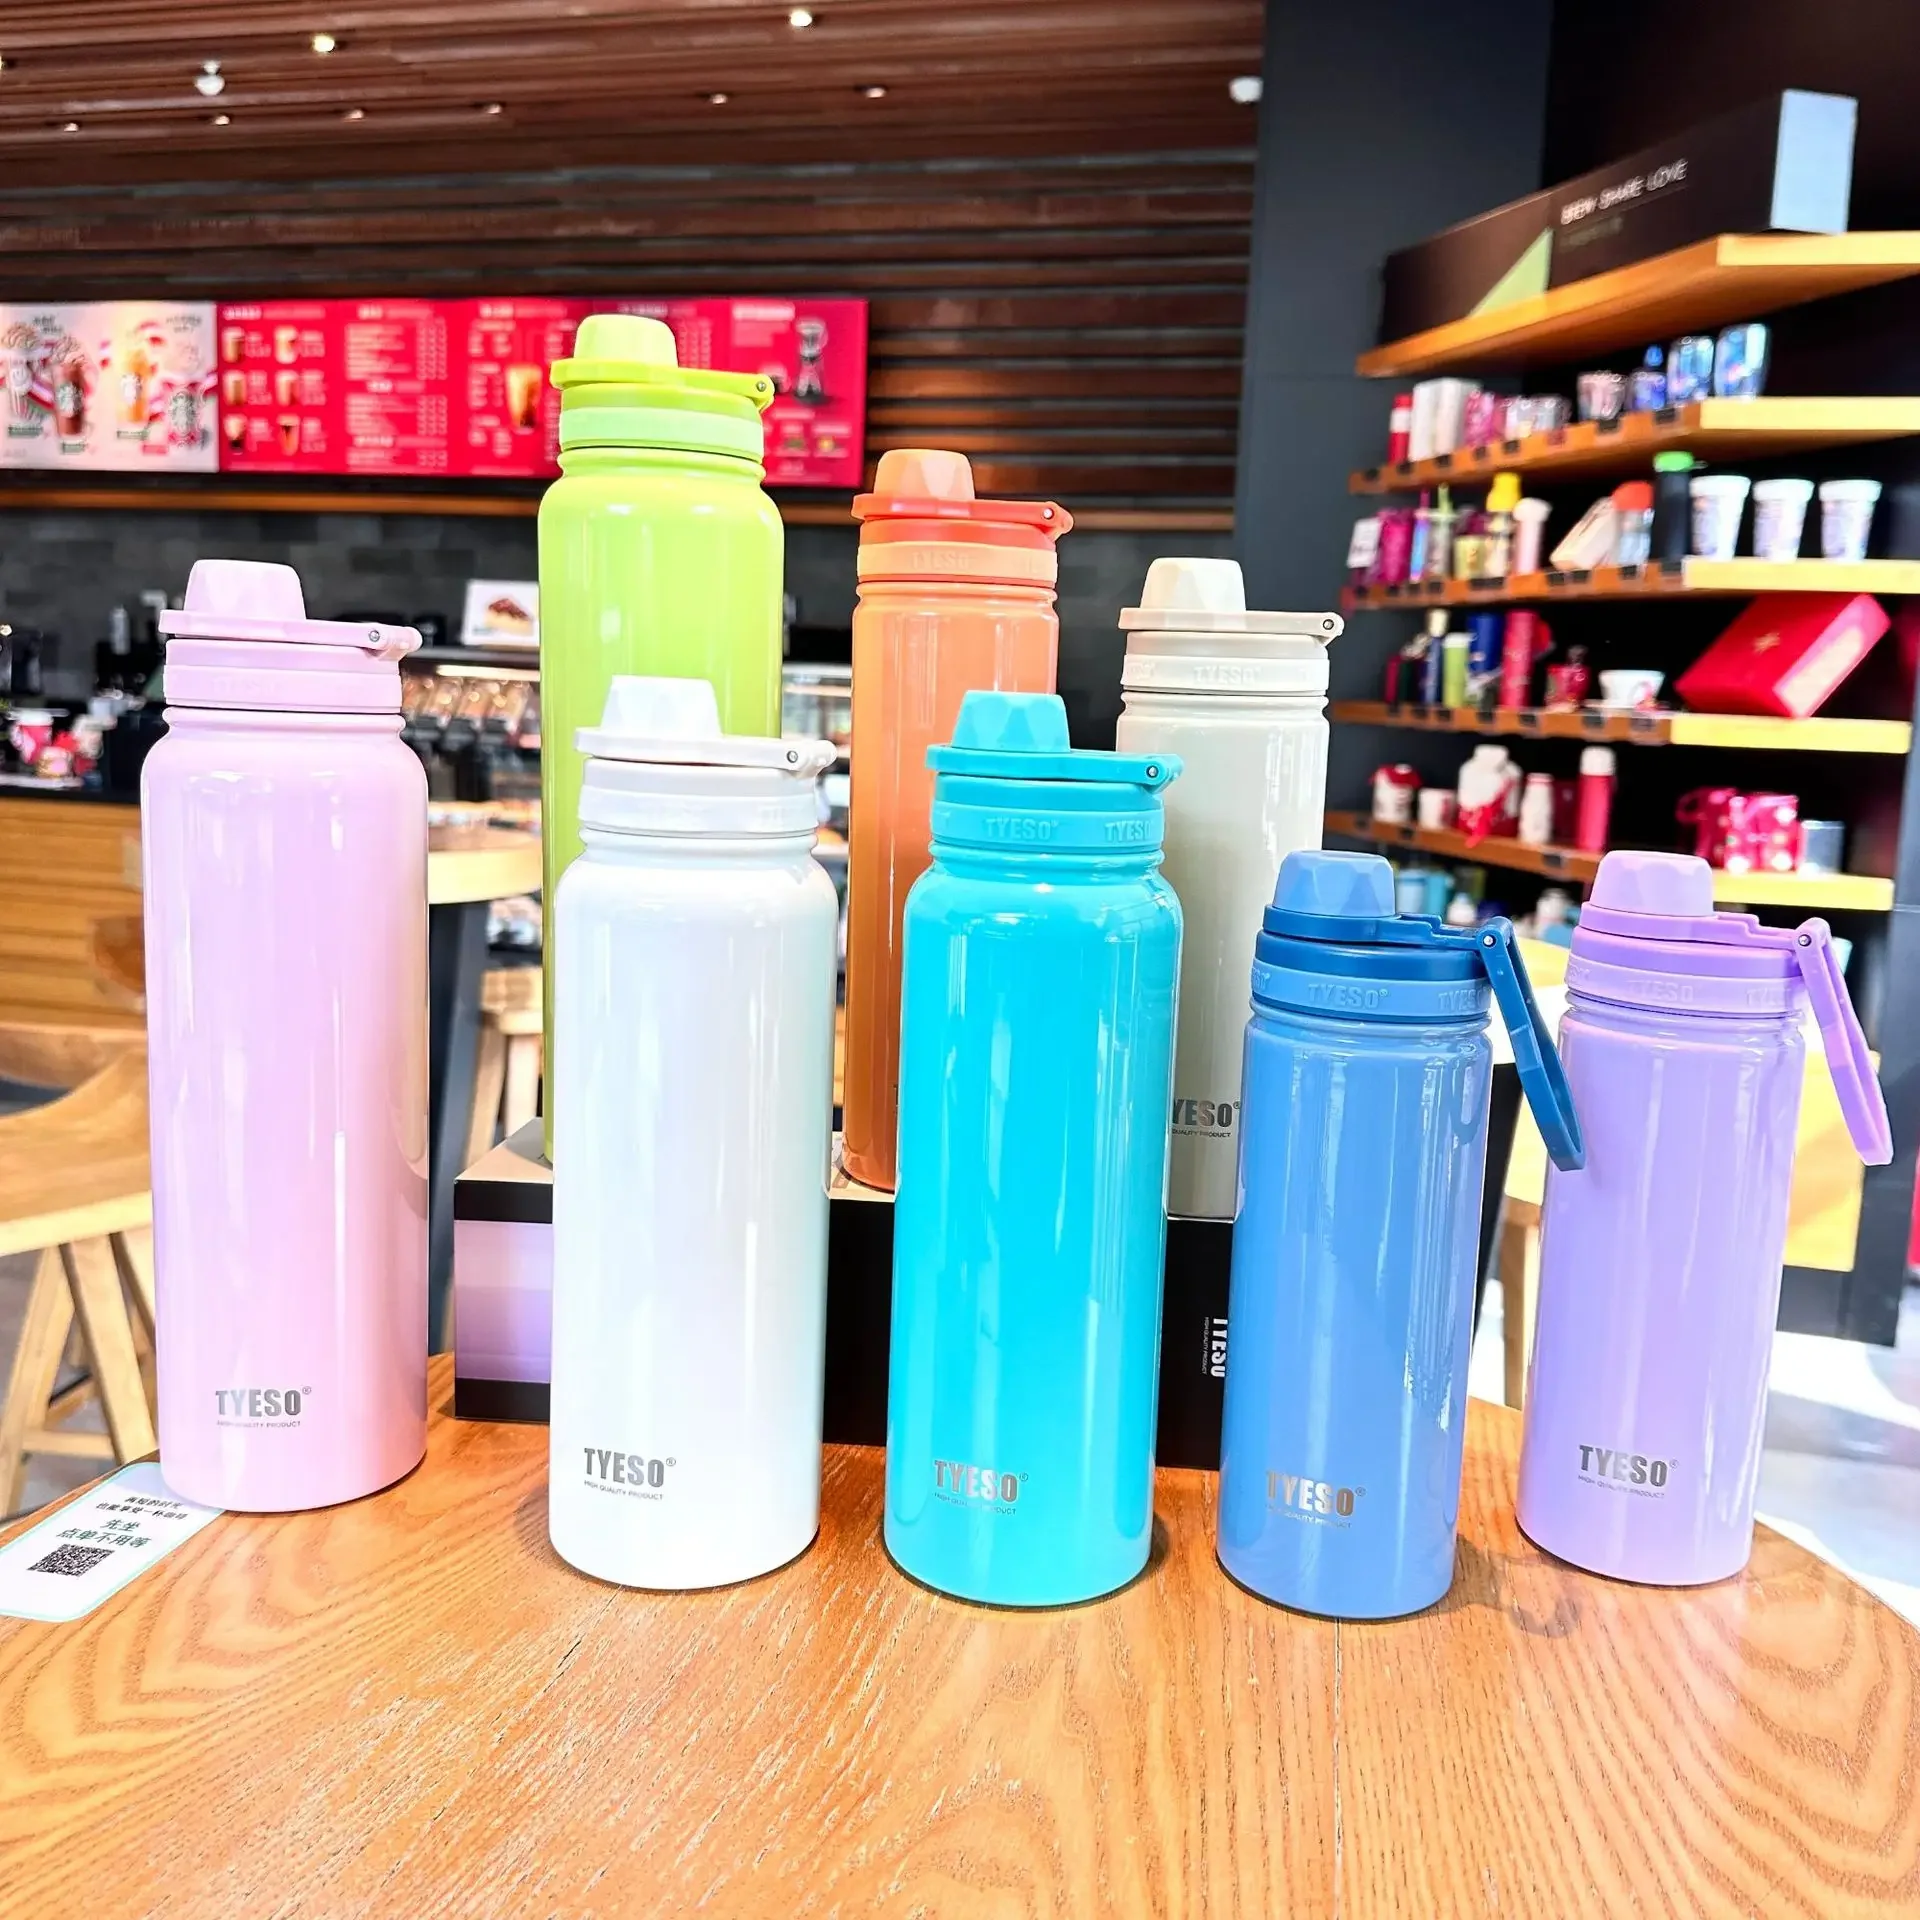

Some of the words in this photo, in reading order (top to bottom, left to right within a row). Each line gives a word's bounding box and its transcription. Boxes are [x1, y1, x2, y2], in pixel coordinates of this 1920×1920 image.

[99, 1518, 140, 1532] 先坐
[56, 1527, 152, 1549] 点单不用等
